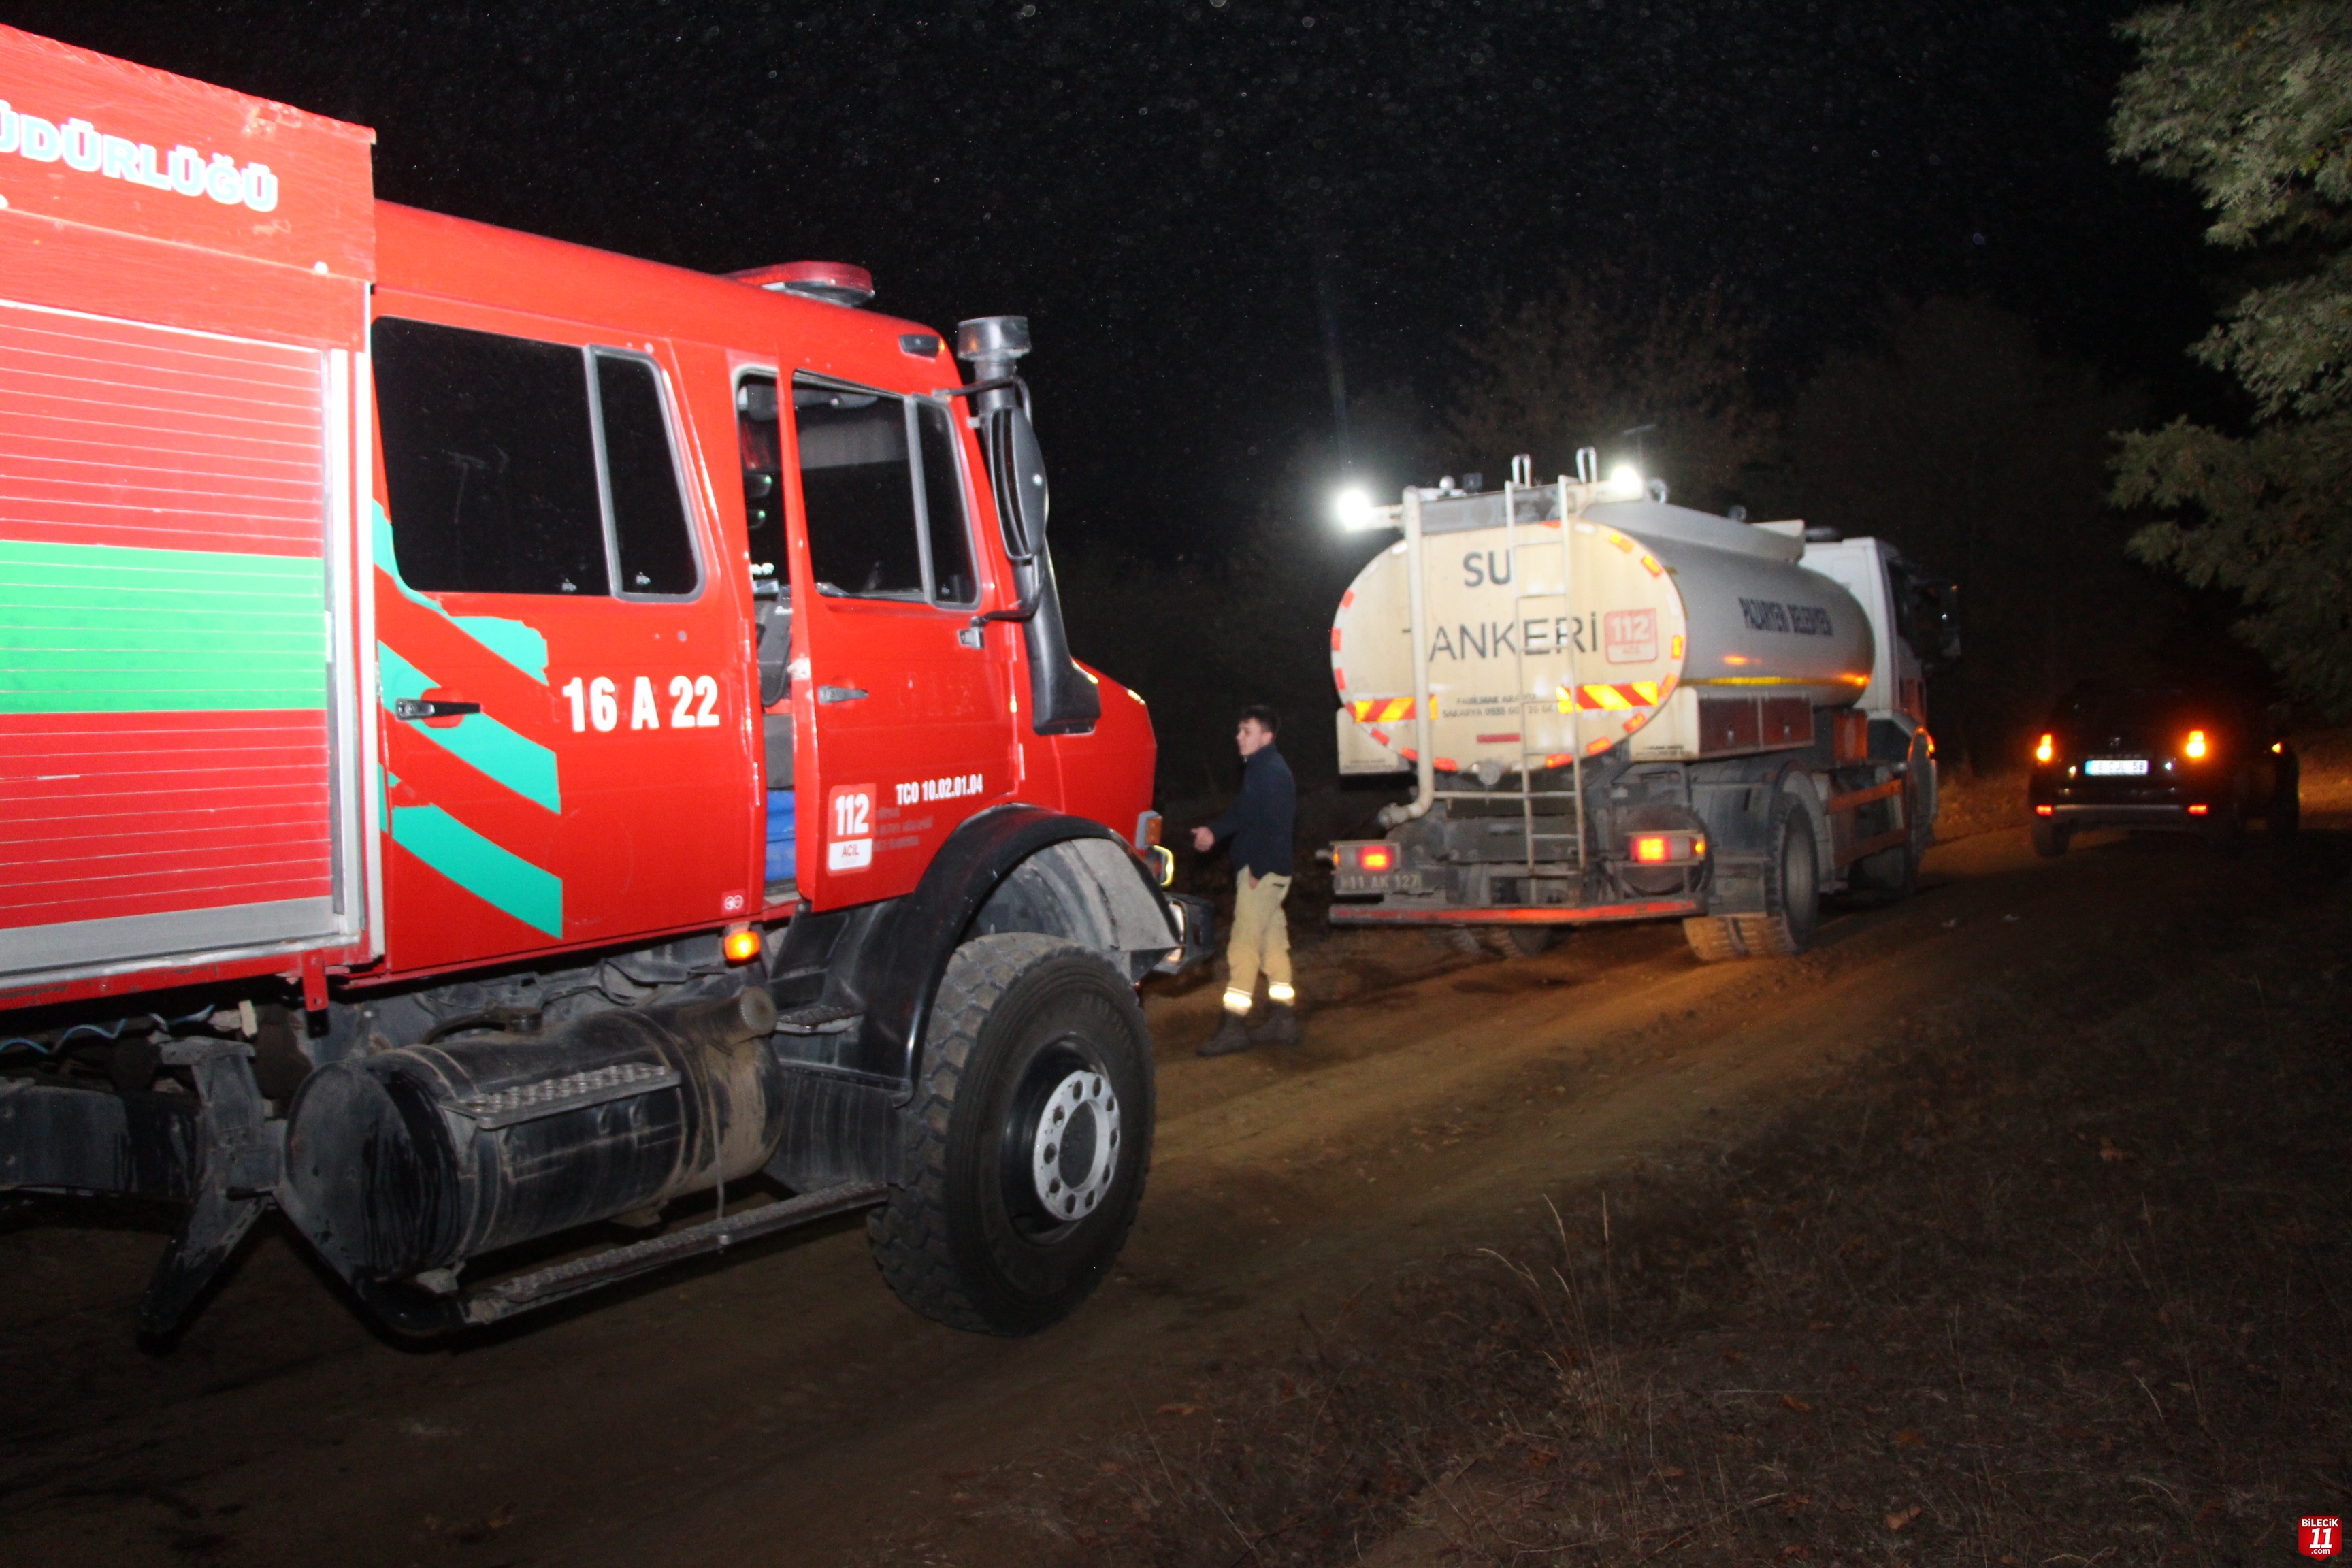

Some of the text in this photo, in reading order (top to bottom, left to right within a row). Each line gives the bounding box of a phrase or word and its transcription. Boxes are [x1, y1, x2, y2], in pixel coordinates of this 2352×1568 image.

[1463, 549, 1511, 588] SU
[1611, 615, 1650, 642] 112
[561, 674, 721, 733] 16 A 22
[922, 773, 983, 802] 10.02.01.04
[835, 793, 870, 836] 112
